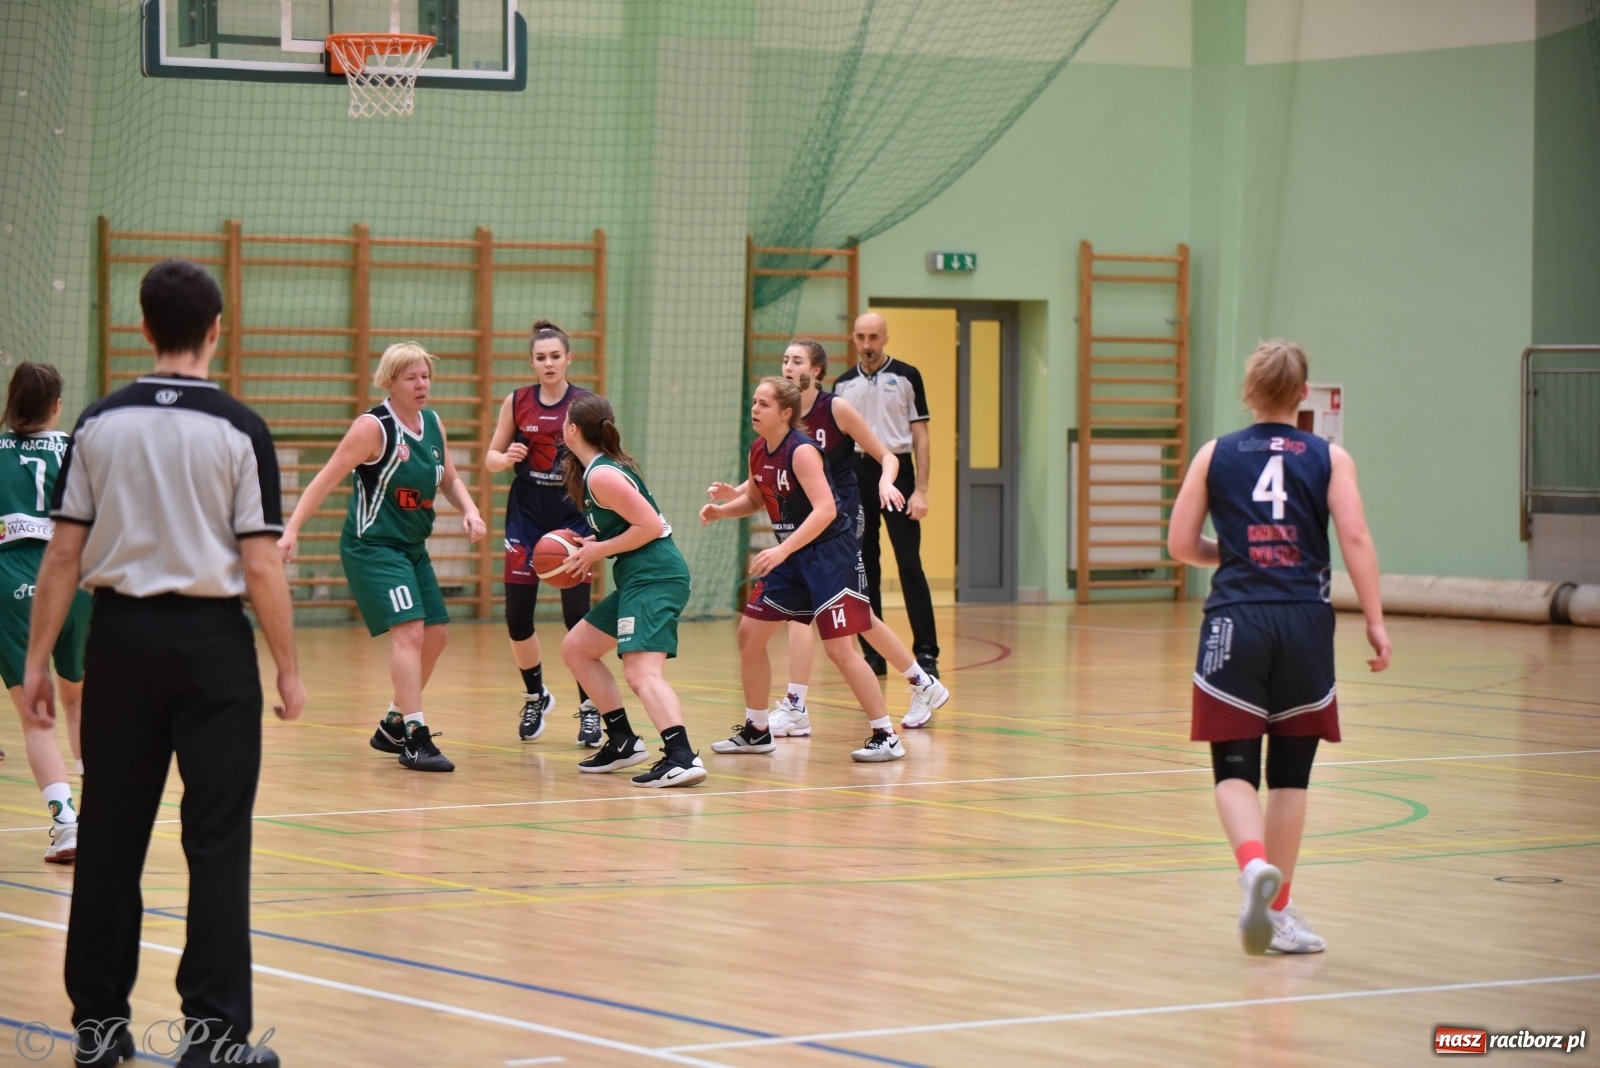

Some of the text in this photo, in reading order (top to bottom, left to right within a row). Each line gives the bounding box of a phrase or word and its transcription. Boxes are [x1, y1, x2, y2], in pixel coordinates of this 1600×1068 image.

[21, 438, 69, 454] RACIBÓ
[815, 429, 826, 449] 9
[19, 454, 47, 511] 7
[776, 469, 791, 491] 14
[1252, 455, 1288, 520] 4
[388, 585, 414, 613] 10
[831, 608, 847, 629] 14
